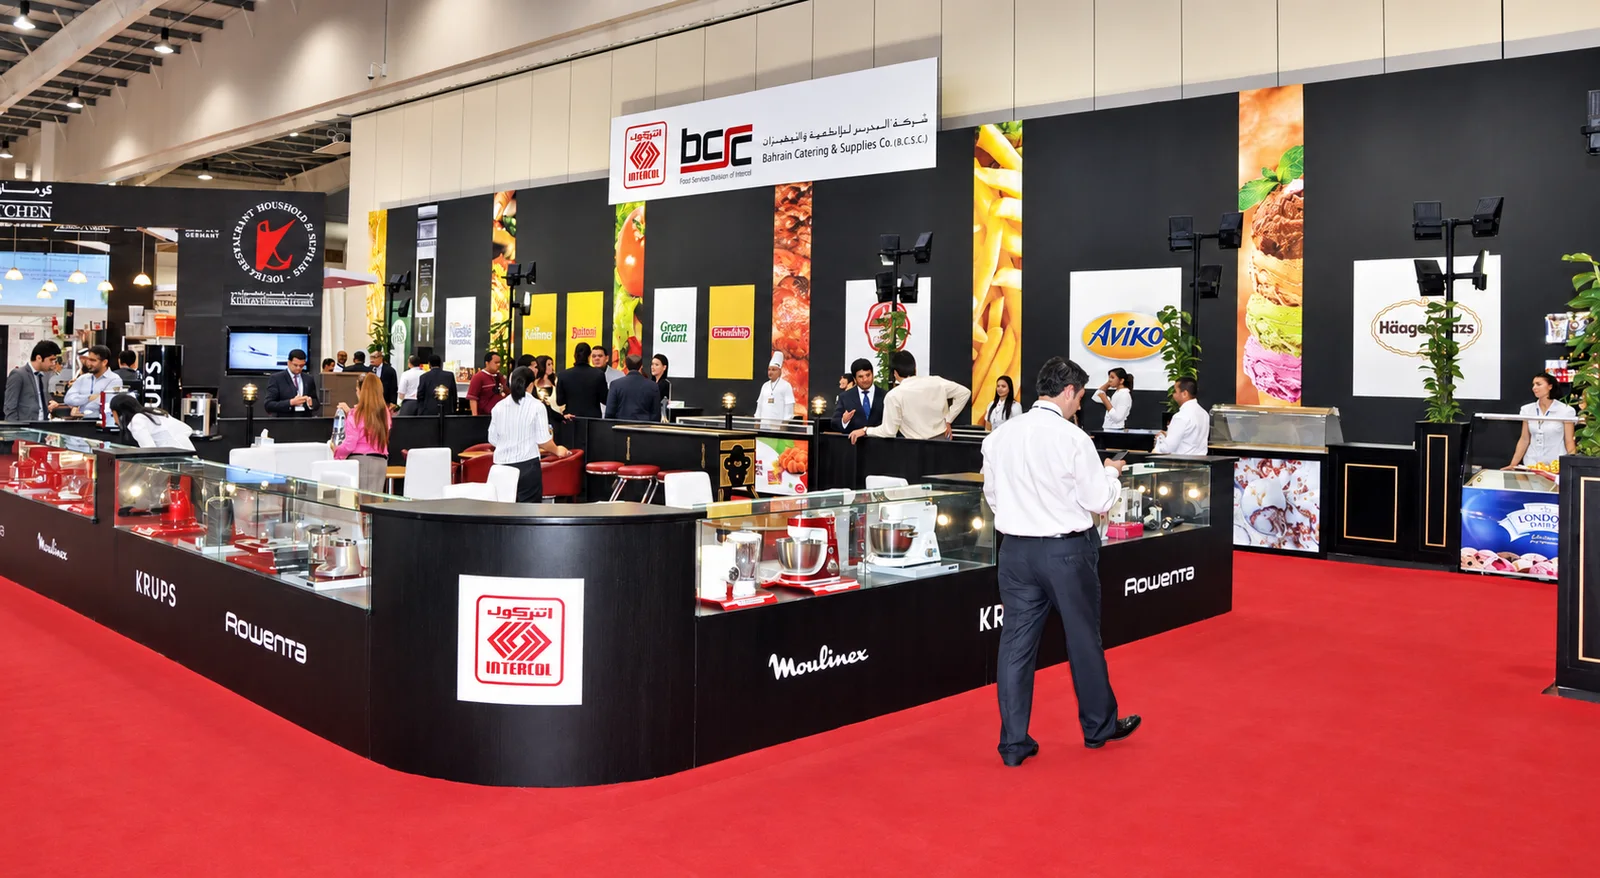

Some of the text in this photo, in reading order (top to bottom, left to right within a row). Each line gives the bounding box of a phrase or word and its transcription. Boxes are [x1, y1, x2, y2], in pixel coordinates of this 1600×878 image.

[762, 151, 793, 163] Bahrain
[794, 145, 829, 159] Catering
[831, 144, 838, 154] &
[840, 138, 877, 156] Supplies
[879, 137, 893, 148] Co.
[692, 175, 711, 184] Services
[660, 321, 688, 332] Green
[713, 326, 749, 339] Friendship
[1087, 318, 1164, 348] Aviko
[1518, 513, 1559, 524] LONDO
[136, 569, 177, 607] KRUPS
[486, 661, 552, 676] INTERCOL
[768, 645, 869, 680] Moulinex
